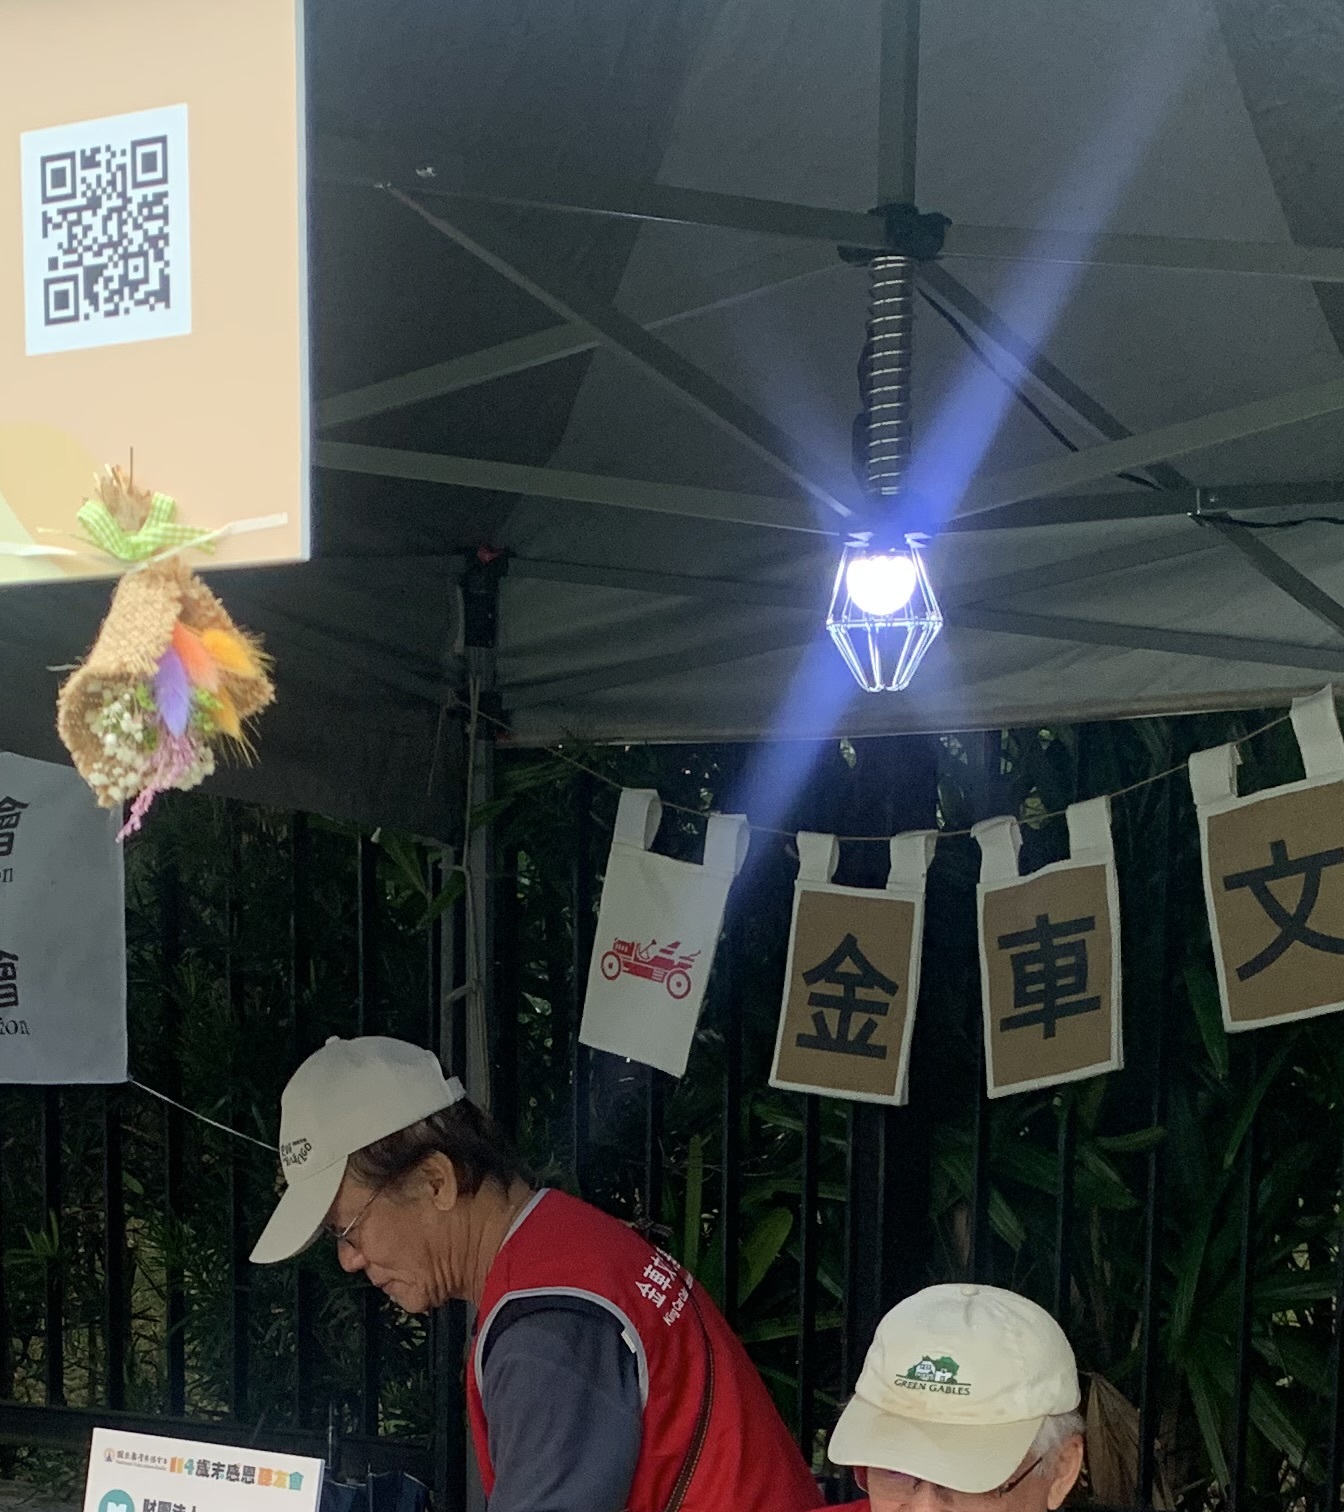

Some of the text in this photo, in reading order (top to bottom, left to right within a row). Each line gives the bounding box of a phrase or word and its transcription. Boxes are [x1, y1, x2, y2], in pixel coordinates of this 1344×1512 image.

[794, 932, 899, 1060] 金
[997, 914, 1102, 1041] 車
[894, 1378, 970, 1396] GREEN GABLES
